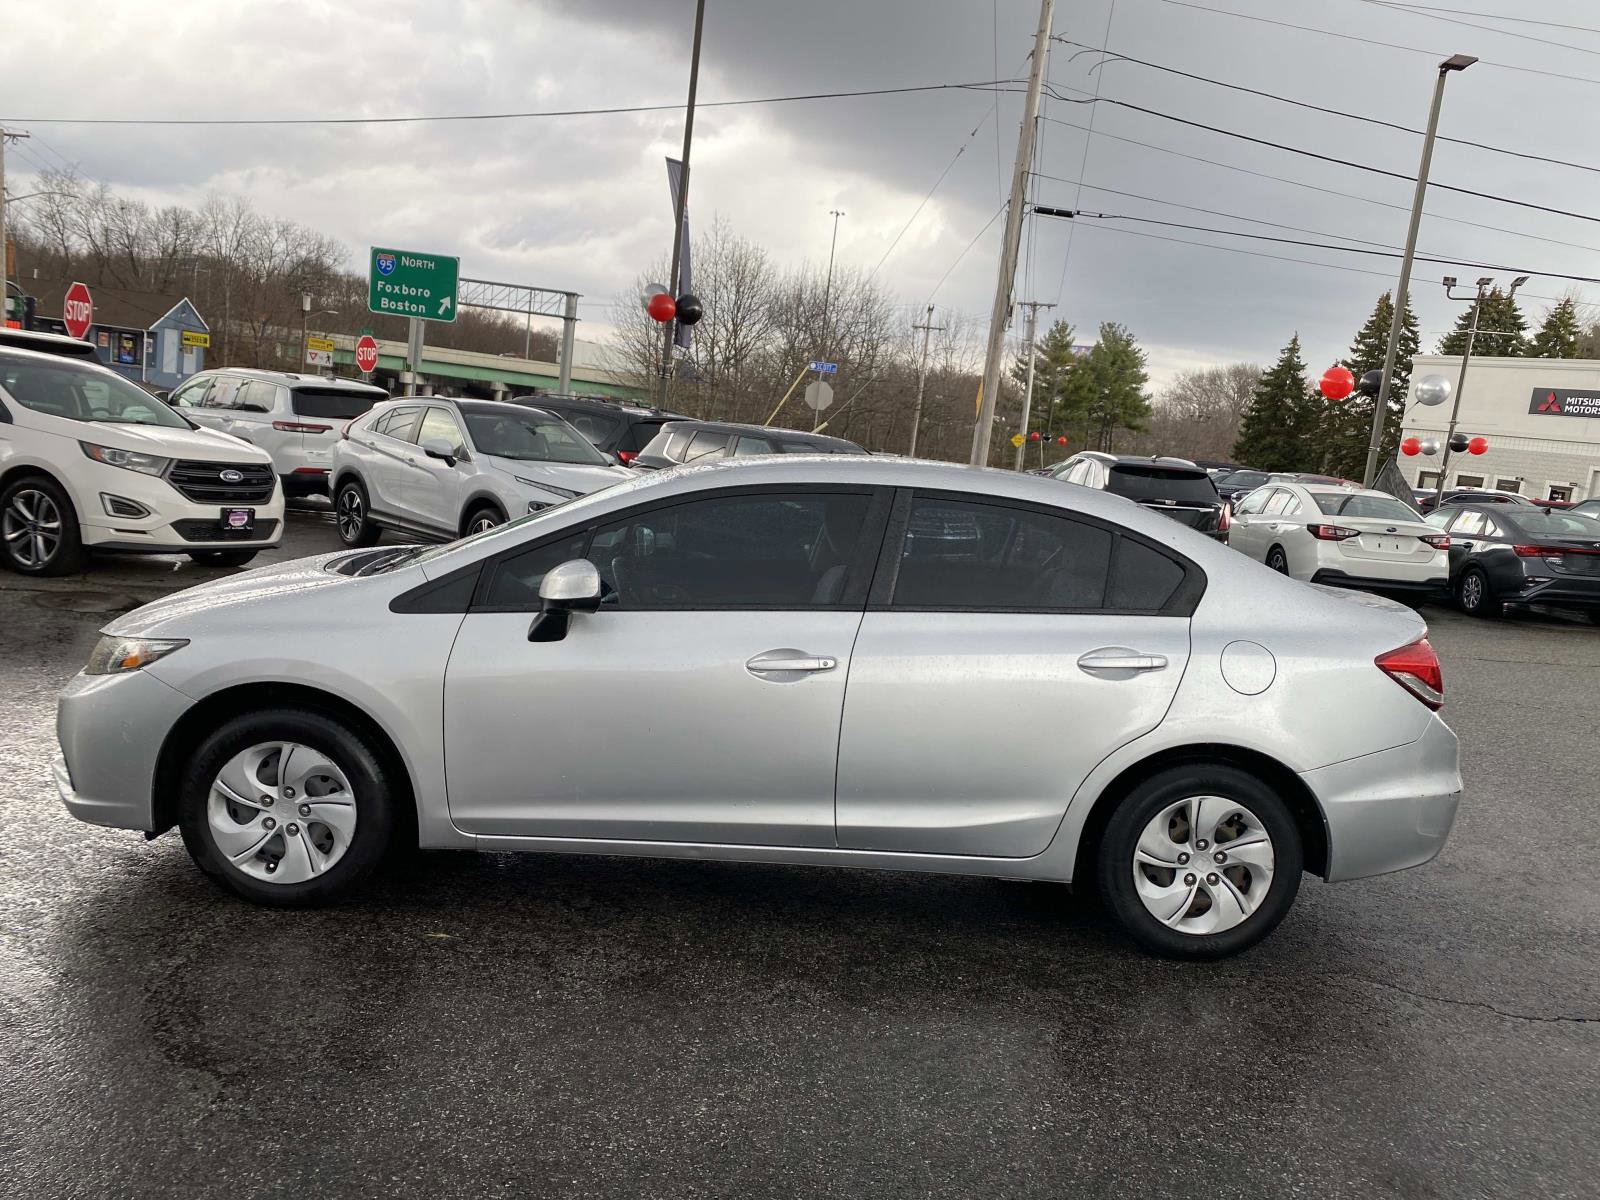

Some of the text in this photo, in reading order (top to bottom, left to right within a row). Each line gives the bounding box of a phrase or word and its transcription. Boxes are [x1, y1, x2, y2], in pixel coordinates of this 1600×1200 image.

[379, 260, 393, 271] 95
[401, 256, 435, 270] NORTH
[377, 281, 431, 298] Foxboro
[66, 300, 90, 322] STOP
[381, 298, 426, 313] Boston
[358, 347, 376, 361] STOP
